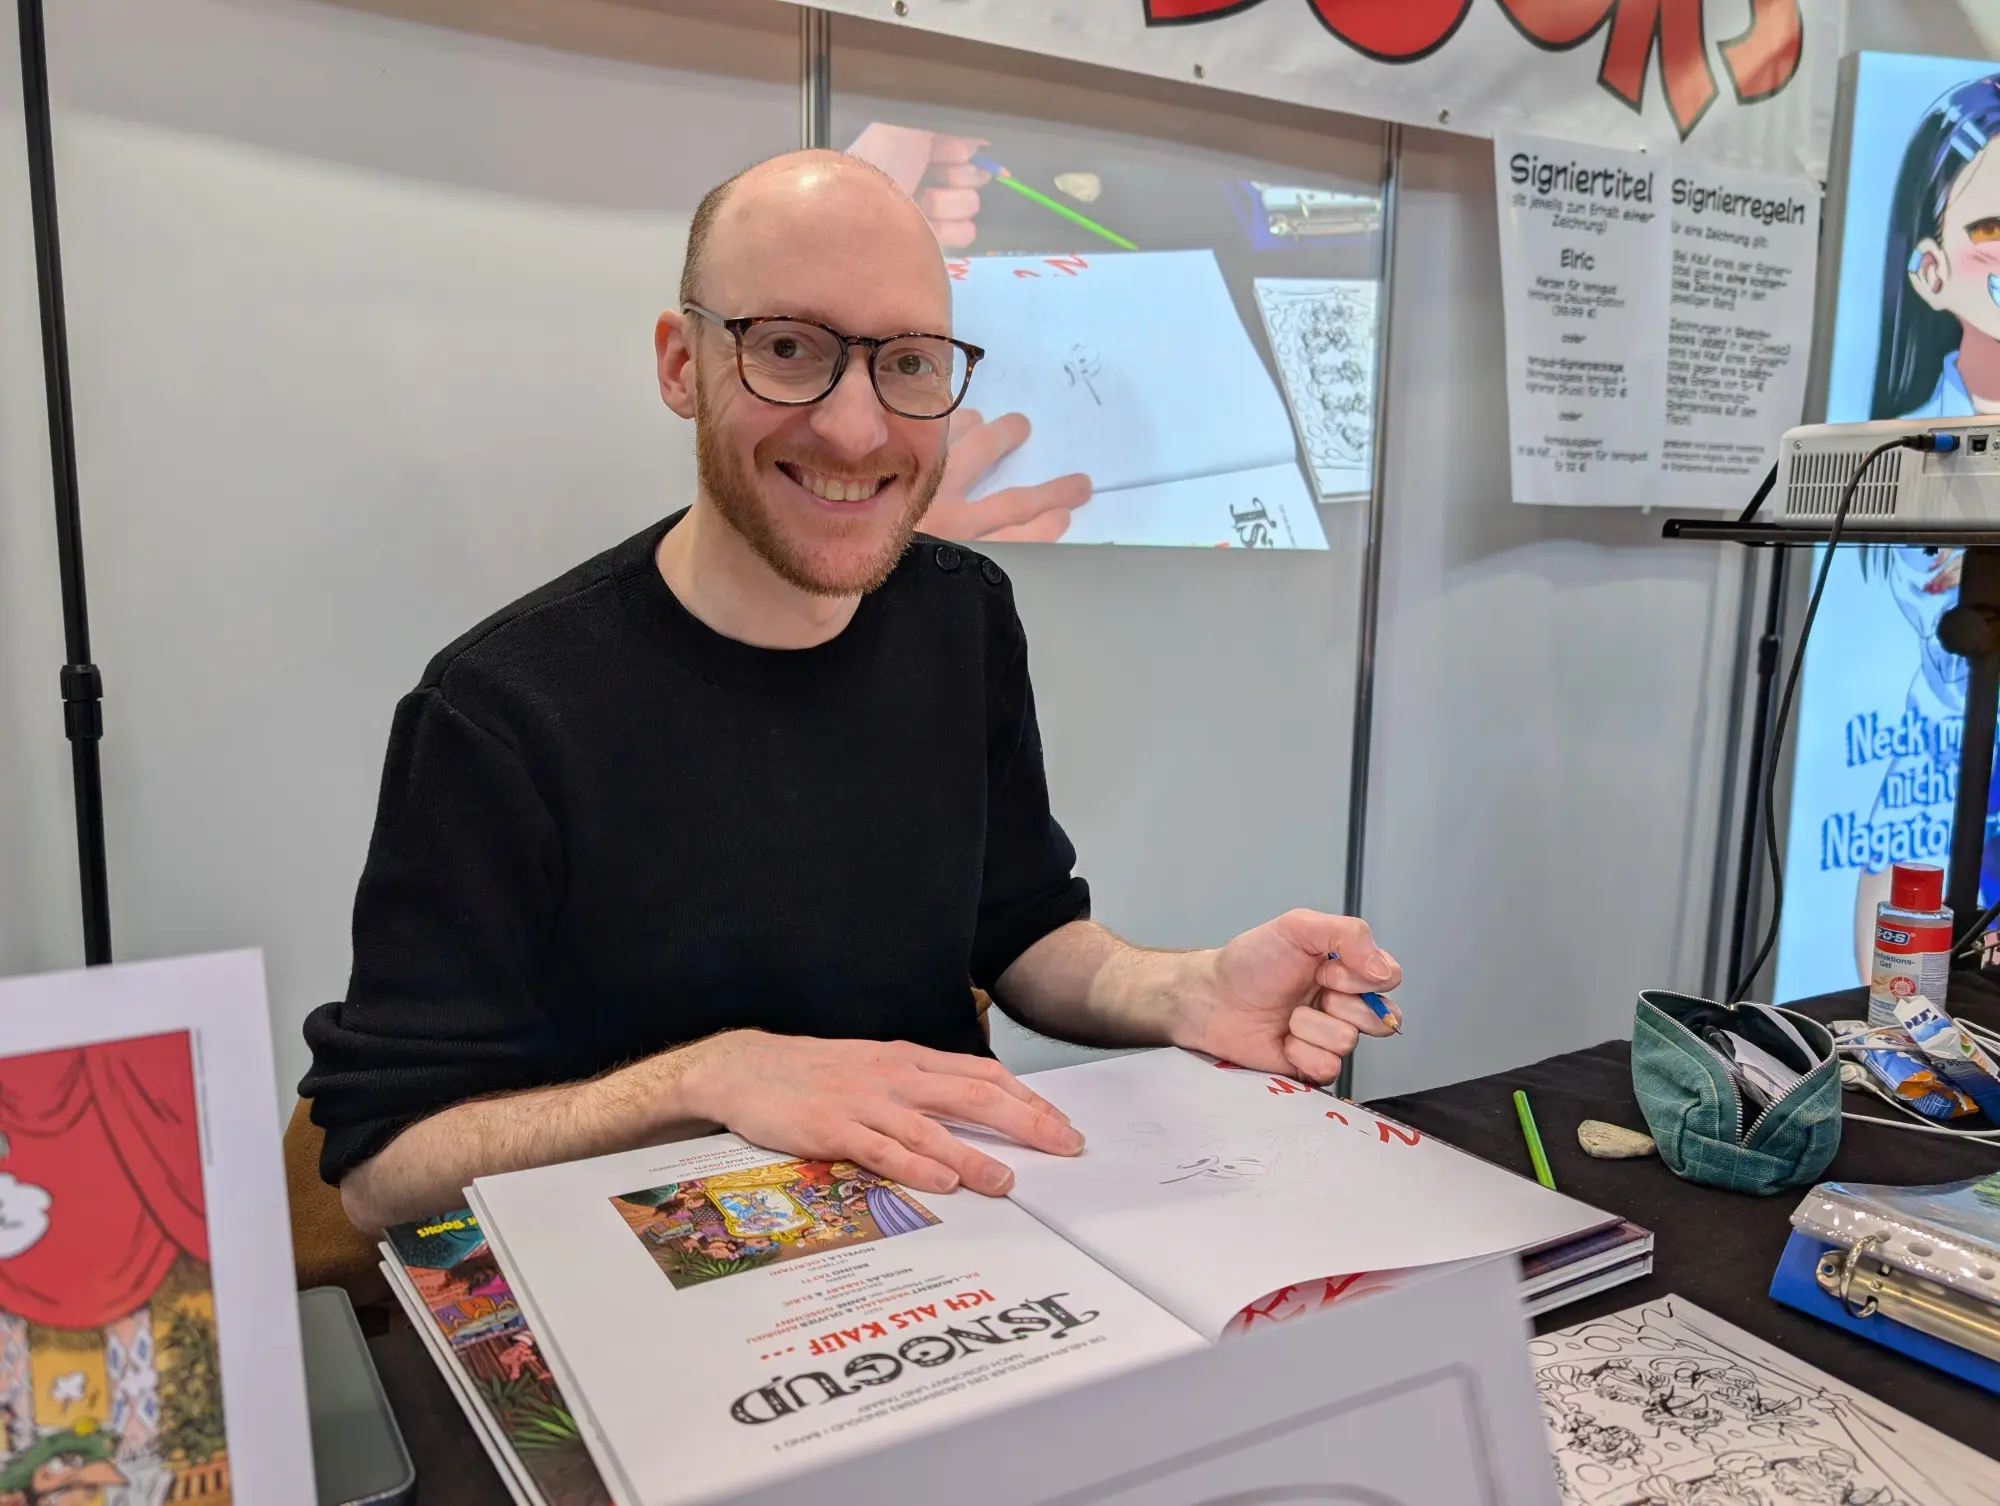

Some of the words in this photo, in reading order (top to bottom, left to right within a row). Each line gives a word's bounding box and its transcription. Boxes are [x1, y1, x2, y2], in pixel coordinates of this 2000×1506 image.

[1510, 152, 1653, 204] Signiertitel
[1529, 197, 1565, 211] jeweils
[1567, 202, 1586, 213] zum
[1590, 203, 1620, 219] Erhalt
[1622, 210, 1655, 223] einer
[1671, 178, 1805, 226] Signierregeln
[1552, 214, 1607, 235] Zeichnung)
[1683, 225, 1704, 236] eine
[1705, 227, 1750, 248] Zeichnung
[1560, 248, 1595, 271] Elric
[1690, 252, 1711, 266] Kauf
[1713, 258, 1735, 271] eines
[1567, 279, 1580, 292] für
[1726, 273, 1747, 285] eine
[1693, 280, 1737, 299] Zeichnung
[1560, 333, 1587, 344] oder
[1620, 387, 1628, 399] €
[1846, 708, 1927, 767] Neck
[1884, 761, 1958, 808] nicht
[1821, 811, 1950, 874] Nagato
[1879, 960, 1891, 968] Gel
[724, 1155, 754, 1164] KLAUS
[416, 1219, 465, 1238] Books
[827, 1245, 875, 1261] NOVELLA
[831, 1261, 869, 1276] BRUNO
[865, 1266, 912, 1283] NICOLAS
[825, 1279, 865, 1295] TABARY
[909, 1276, 958, 1295] LAURENT
[781, 1293, 813, 1308] ELRIC
[835, 1295, 866, 1309] ANNE
[943, 1284, 994, 1314] ICH
[774, 1304, 834, 1327] GOSCINNY
[798, 1310, 843, 1327] OLIVIER
[888, 1302, 937, 1331] ALS
[745, 1323, 798, 1344] ANDRIEU
[729, 1292, 1100, 1426] ISNOGUD
[990, 1350, 1023, 1368] NACH
[990, 1352, 1050, 1379] ABENTEUER
[966, 1373, 988, 1387] DES
[900, 1383, 929, 1400] UND
[856, 1393, 900, 1414] TABARY
[782, 1429, 820, 1448] BAND
